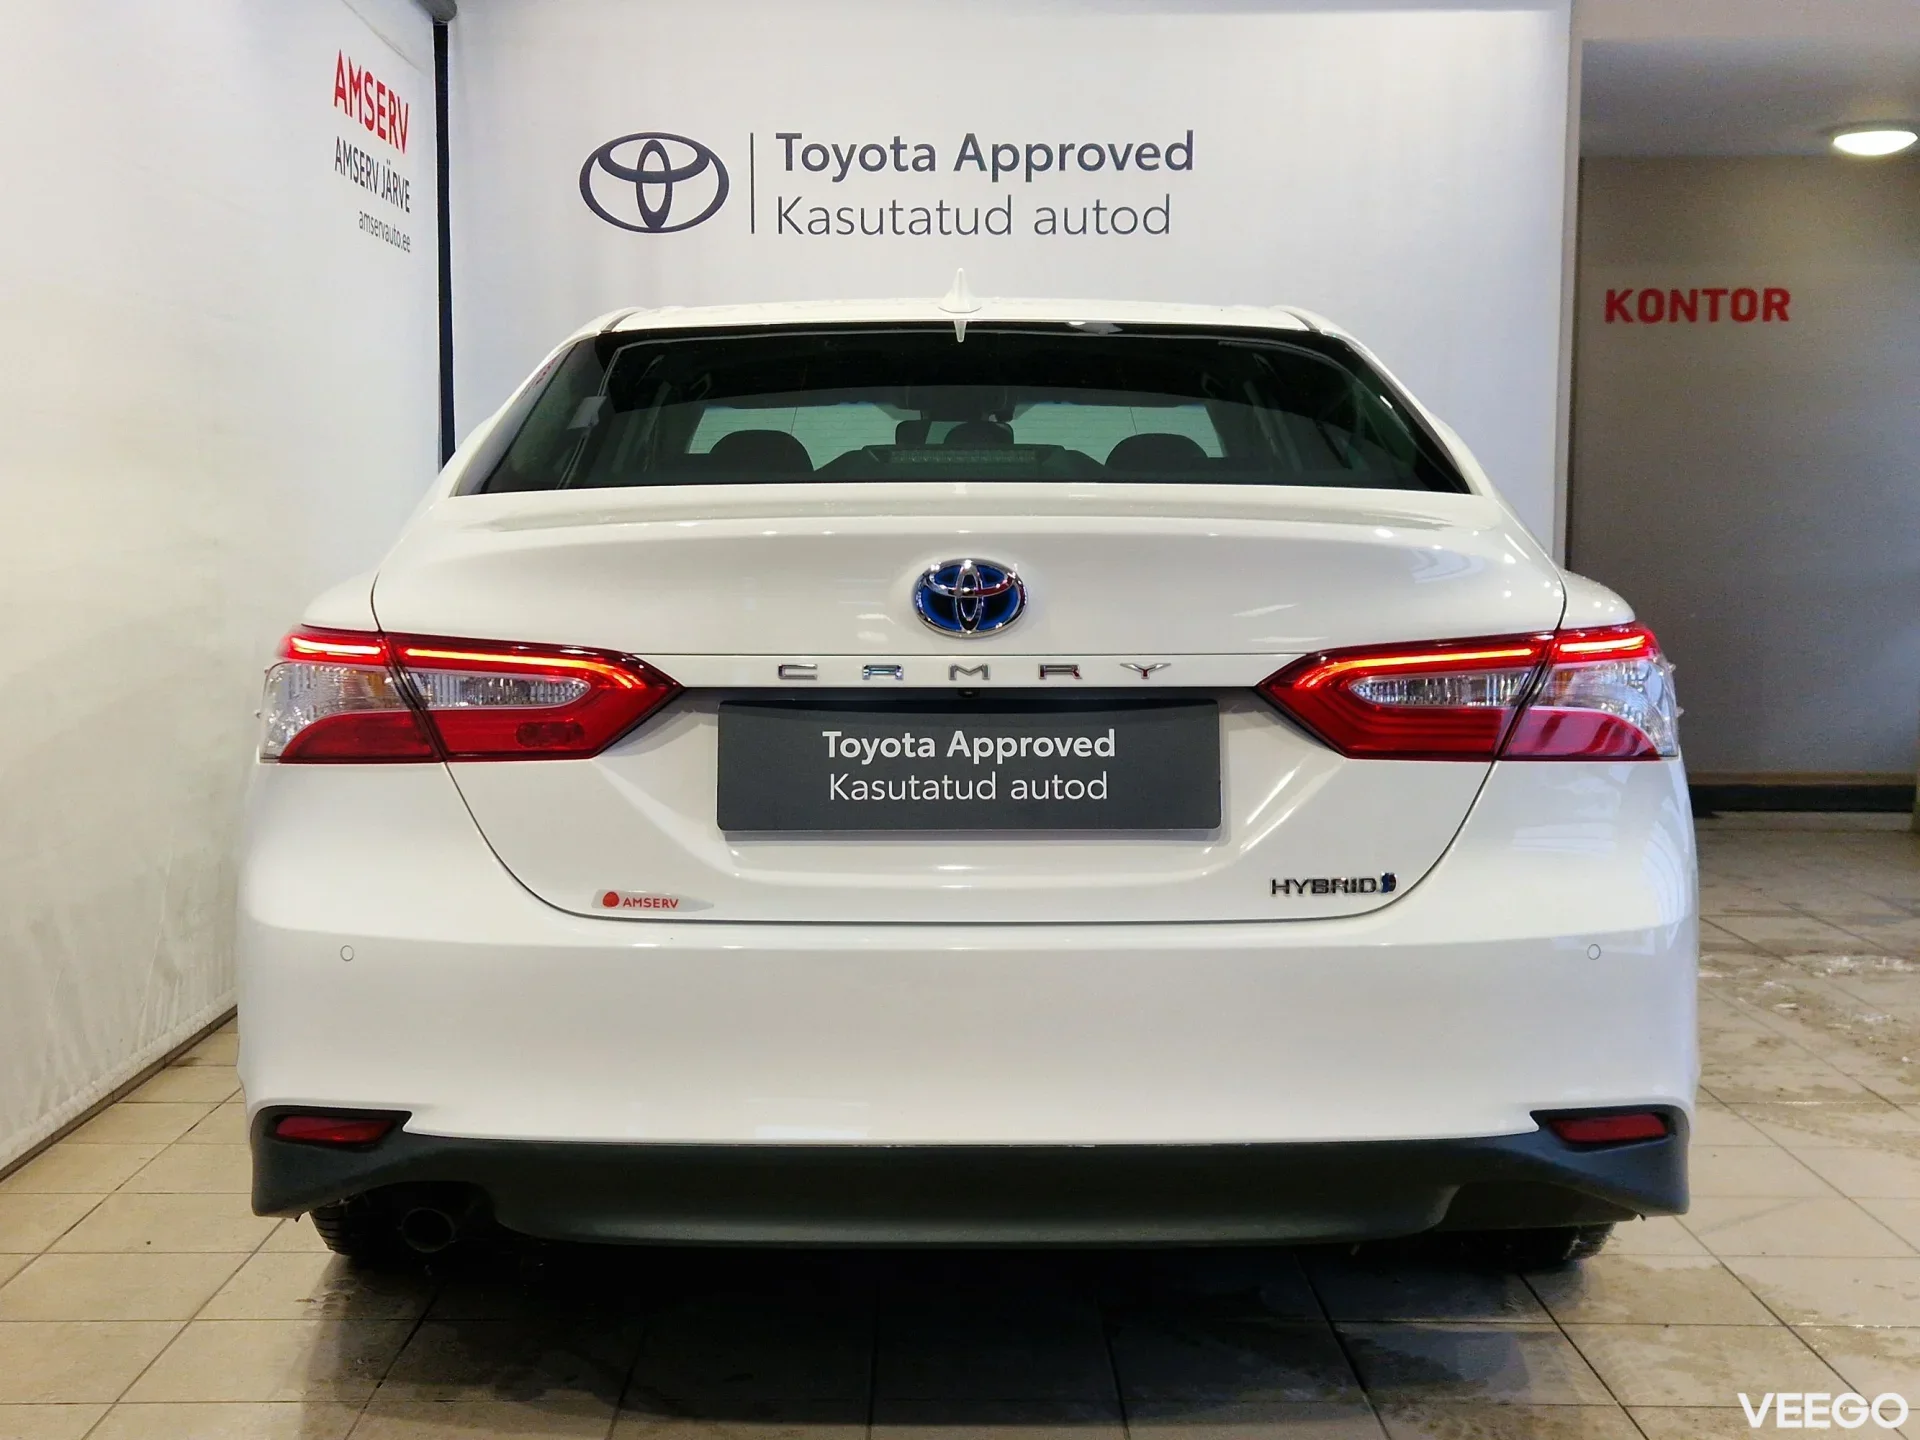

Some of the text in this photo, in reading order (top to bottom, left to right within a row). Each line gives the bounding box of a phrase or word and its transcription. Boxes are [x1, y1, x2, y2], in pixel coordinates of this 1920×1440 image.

[333, 49, 409, 154] AMSERV
[775, 129, 1194, 182] Toyota Approved
[334, 136, 410, 213] AMSERV JÄRVE
[358, 210, 411, 253] amservauto.ee
[777, 193, 1170, 236] Kasutatud autod
[1604, 287, 1791, 324] KONTOR
[777, 662, 1172, 682] CAMRY
[822, 728, 1117, 764] Toyota Approved
[828, 771, 1109, 802] Kasutatud autod
[622, 896, 680, 909] AMSERV
[1270, 877, 1378, 895] HYBRID
